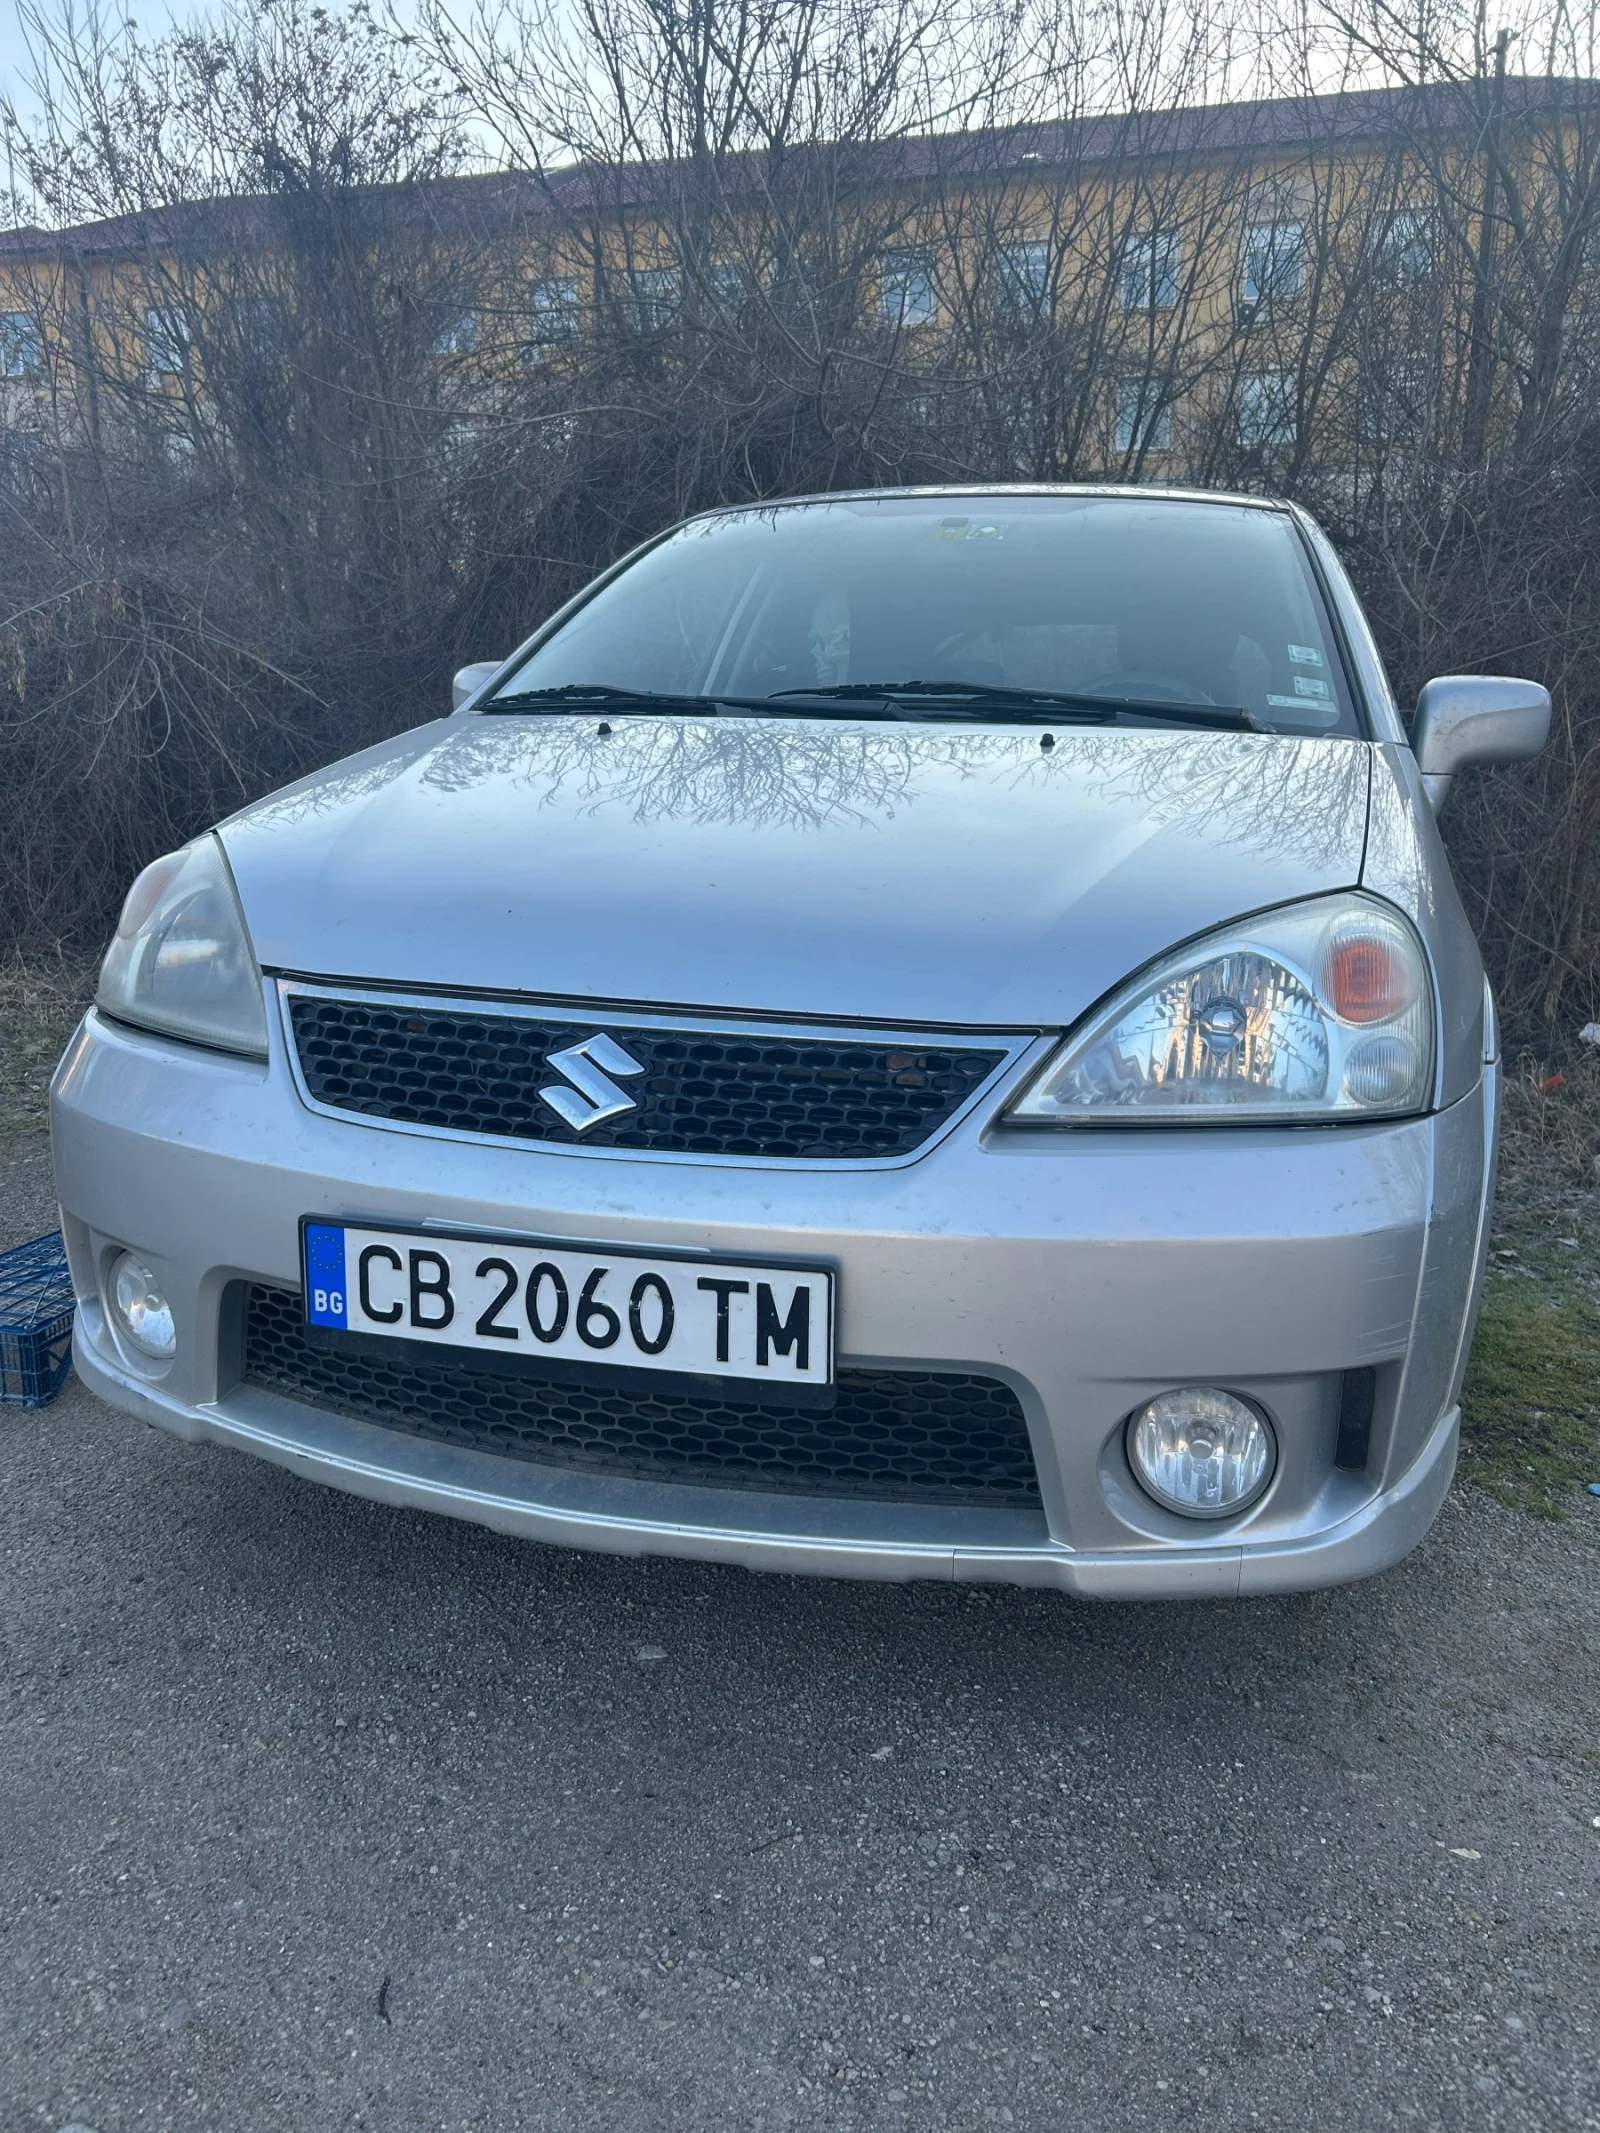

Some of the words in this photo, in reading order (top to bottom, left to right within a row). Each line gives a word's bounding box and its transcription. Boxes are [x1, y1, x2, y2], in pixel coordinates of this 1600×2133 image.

[314, 1288, 343, 1315] BG
[359, 1244, 454, 1330] CB
[475, 1257, 674, 1355] 2060
[697, 1277, 810, 1370] TM
